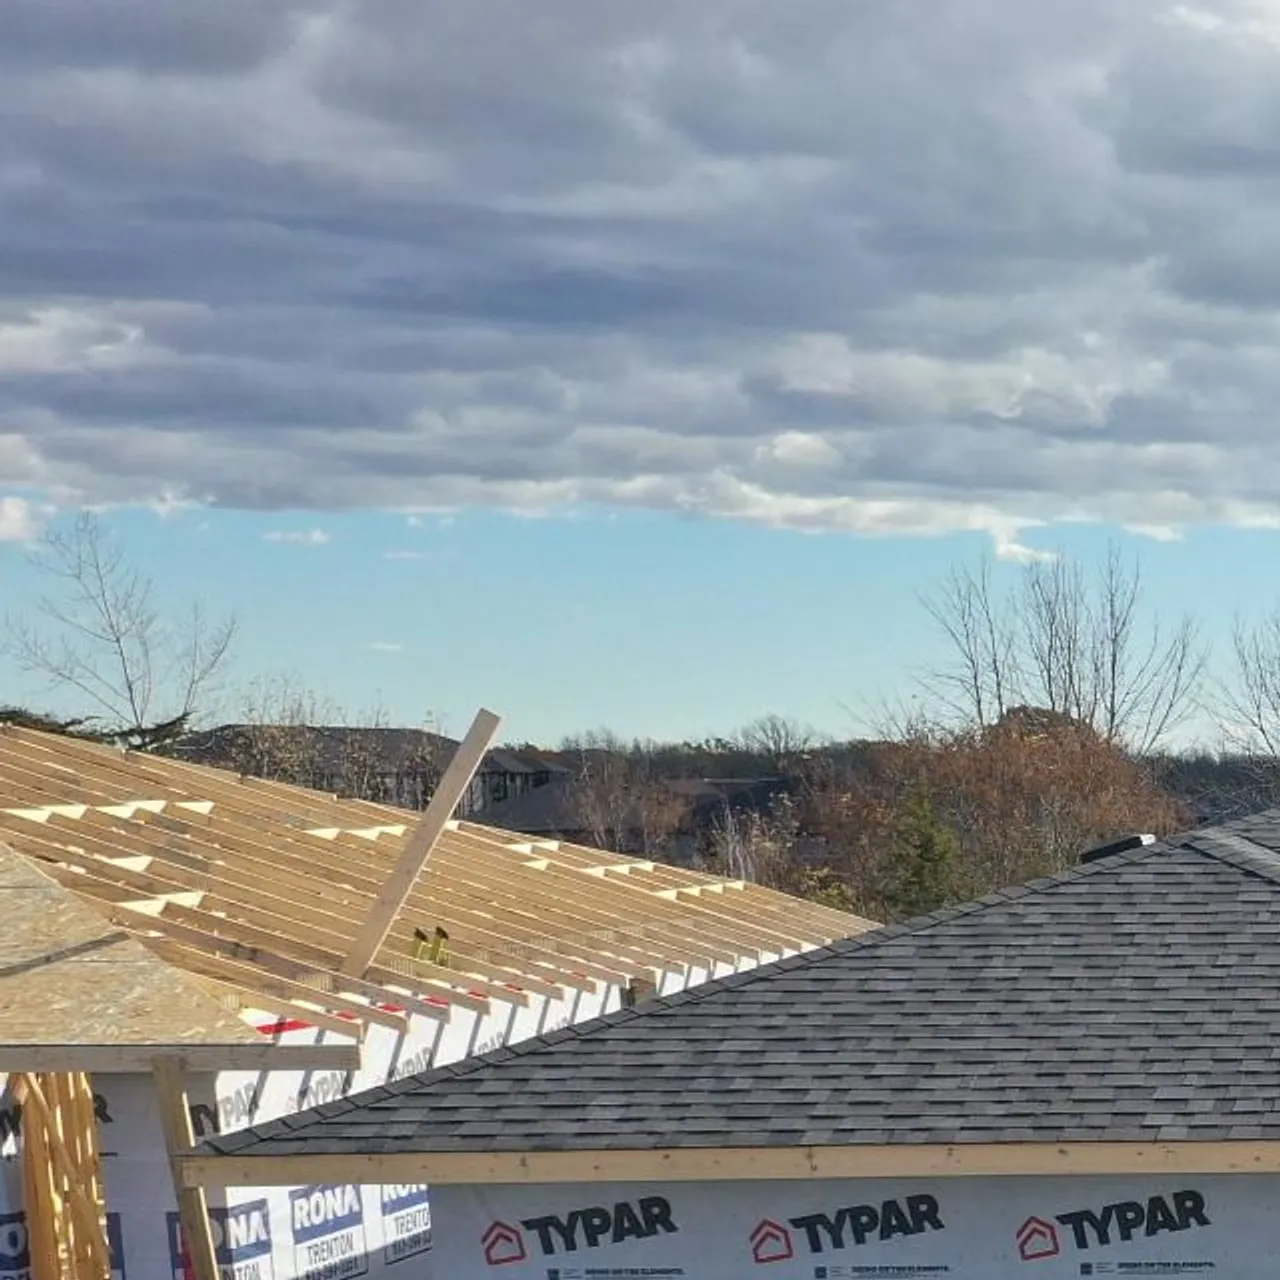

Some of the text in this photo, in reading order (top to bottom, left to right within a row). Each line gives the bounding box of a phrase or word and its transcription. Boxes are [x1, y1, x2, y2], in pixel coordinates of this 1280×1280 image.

[295, 1184, 360, 1230] RONA
[521, 1196, 679, 1255] TYPAR
[789, 1194, 944, 1253] TYPAR
[1055, 1190, 1212, 1249] TYPAR
